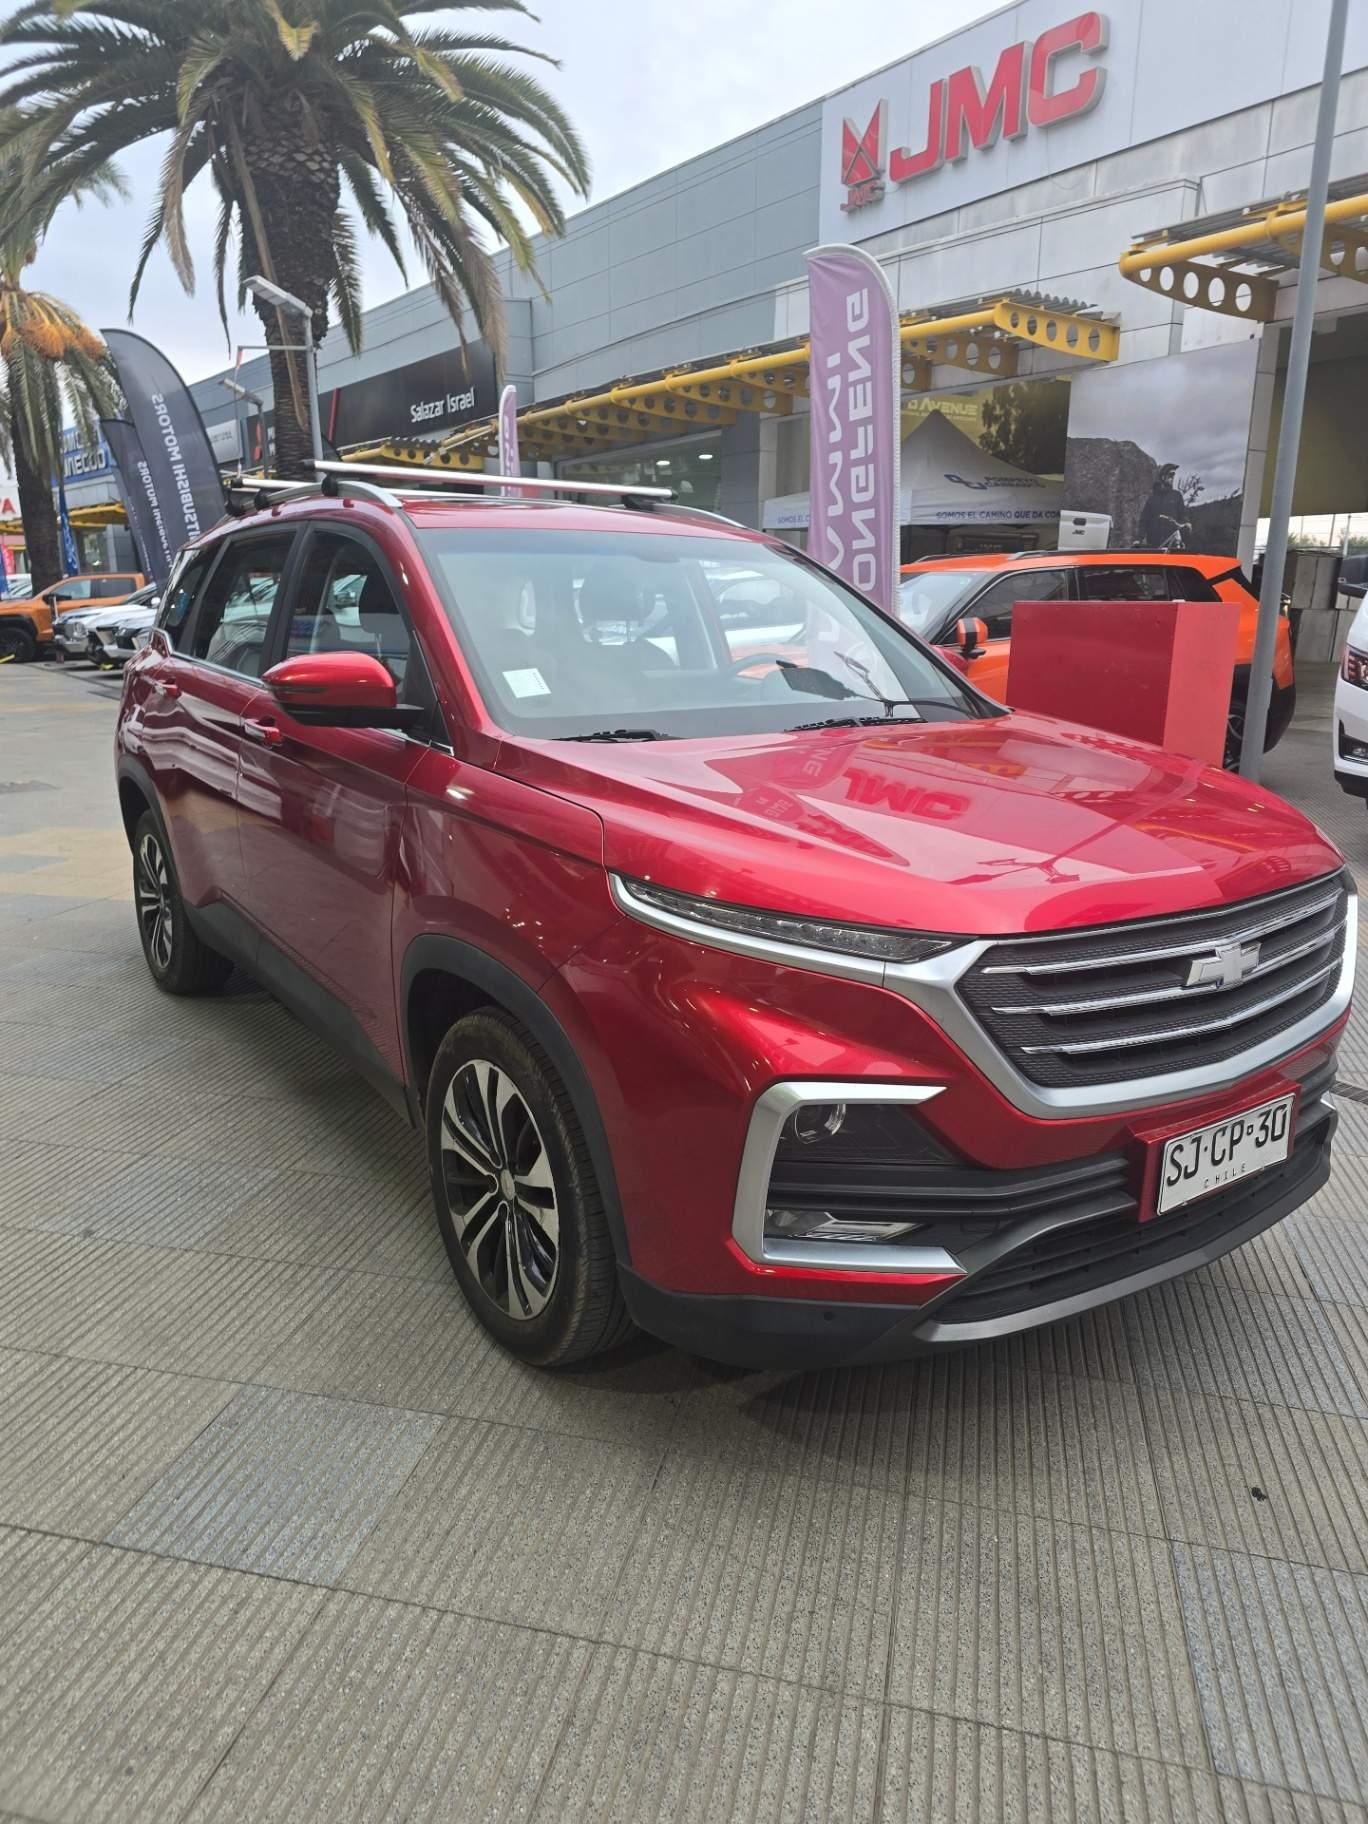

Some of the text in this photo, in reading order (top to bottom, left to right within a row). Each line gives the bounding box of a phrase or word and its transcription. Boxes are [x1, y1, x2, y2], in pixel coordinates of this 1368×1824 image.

[889, 11, 1109, 184] JMC
[410, 400, 445, 423] Salazar
[446, 386, 475, 413] Israel
[936, 511, 966, 520] SOMOS
[967, 511, 977, 519] EL
[979, 511, 1013, 519] CAMINO
[1014, 511, 1031, 519] QUE
[1032, 511, 1043, 519] DA
